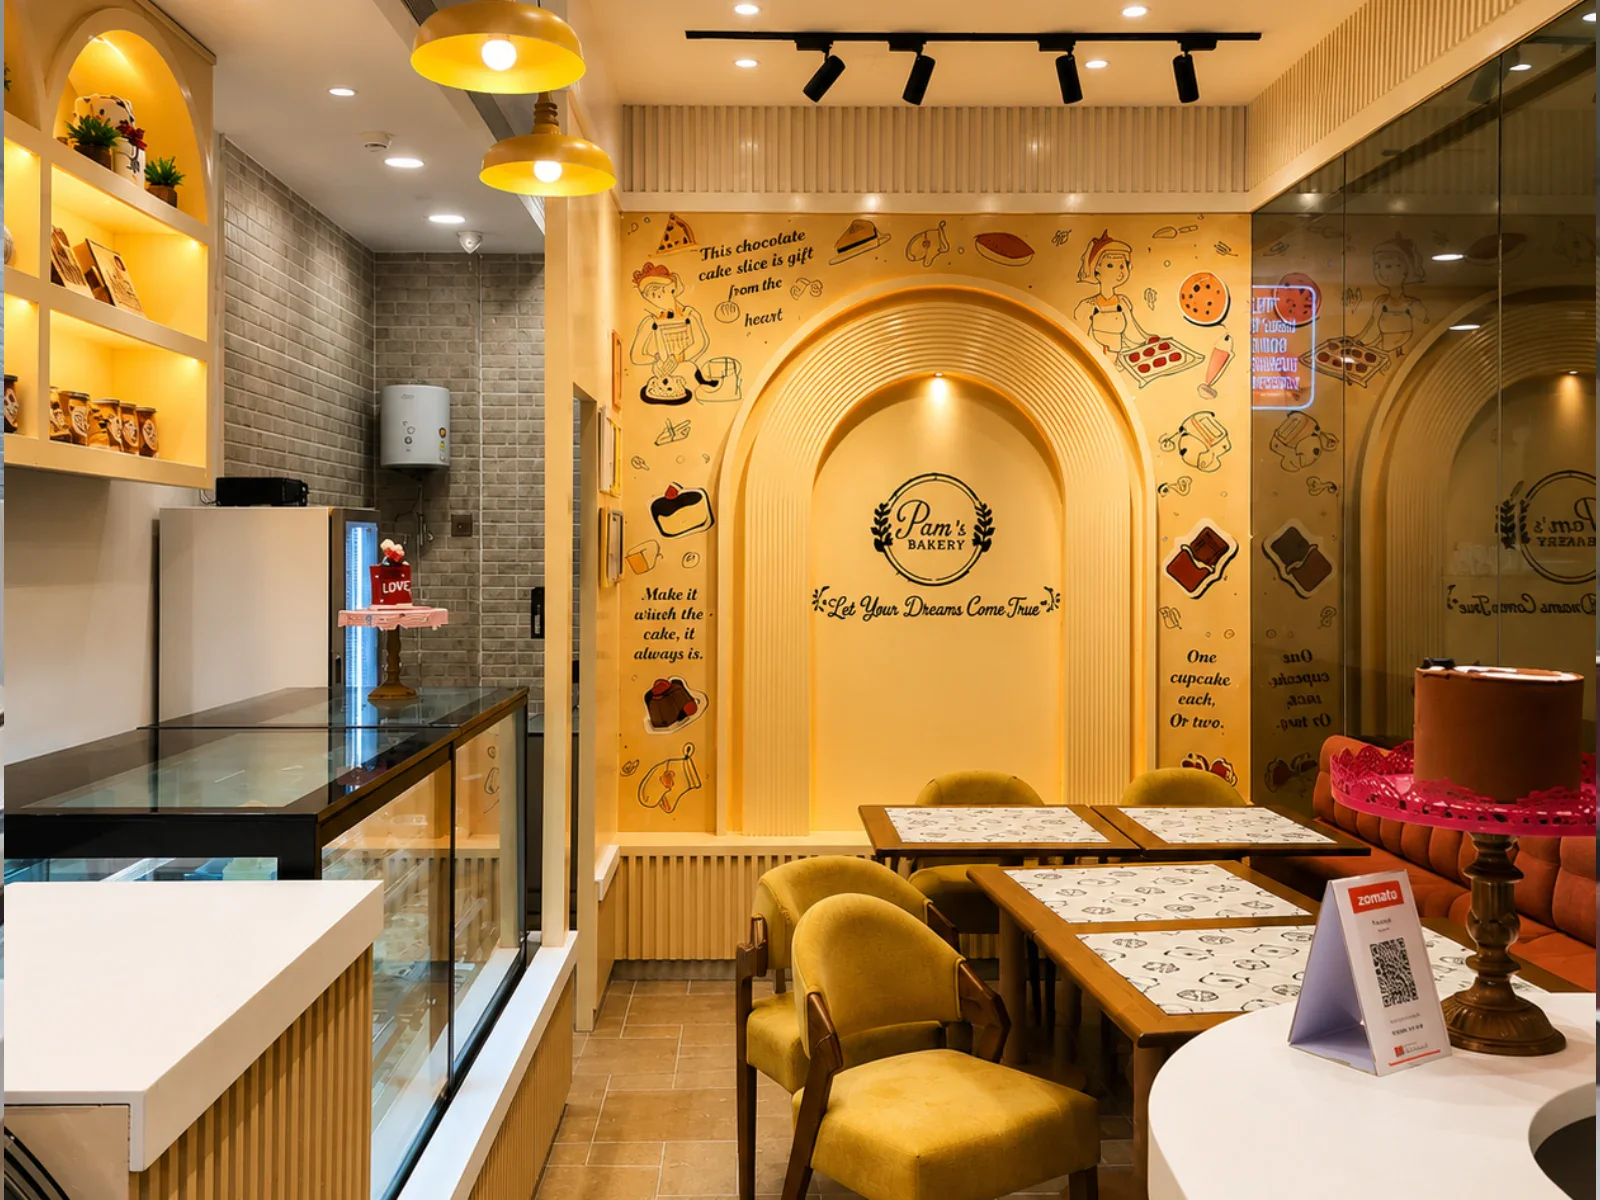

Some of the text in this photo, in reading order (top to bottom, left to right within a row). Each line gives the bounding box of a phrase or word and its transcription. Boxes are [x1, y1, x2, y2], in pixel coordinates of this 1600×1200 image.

[700, 231, 806, 262] This chocolate
[698, 246, 814, 282] cake slice is gift
[728, 277, 782, 301] from the
[744, 307, 783, 327] heart
[895, 499, 967, 540] Pam's
[907, 539, 966, 551] BAKERY
[382, 579, 411, 595] LOVE
[641, 587, 698, 601] Make it
[681, 607, 704, 620] the
[827, 595, 1041, 622] Let Your Dreams Come True
[643, 626, 696, 642] cake, it
[633, 646, 703, 664] always is.
[1186, 649, 1218, 664] One
[1170, 672, 1231, 688] cupcake
[1178, 692, 1215, 708] each,
[1169, 713, 1224, 729] Or two.
[1357, 889, 1398, 907] zomato
